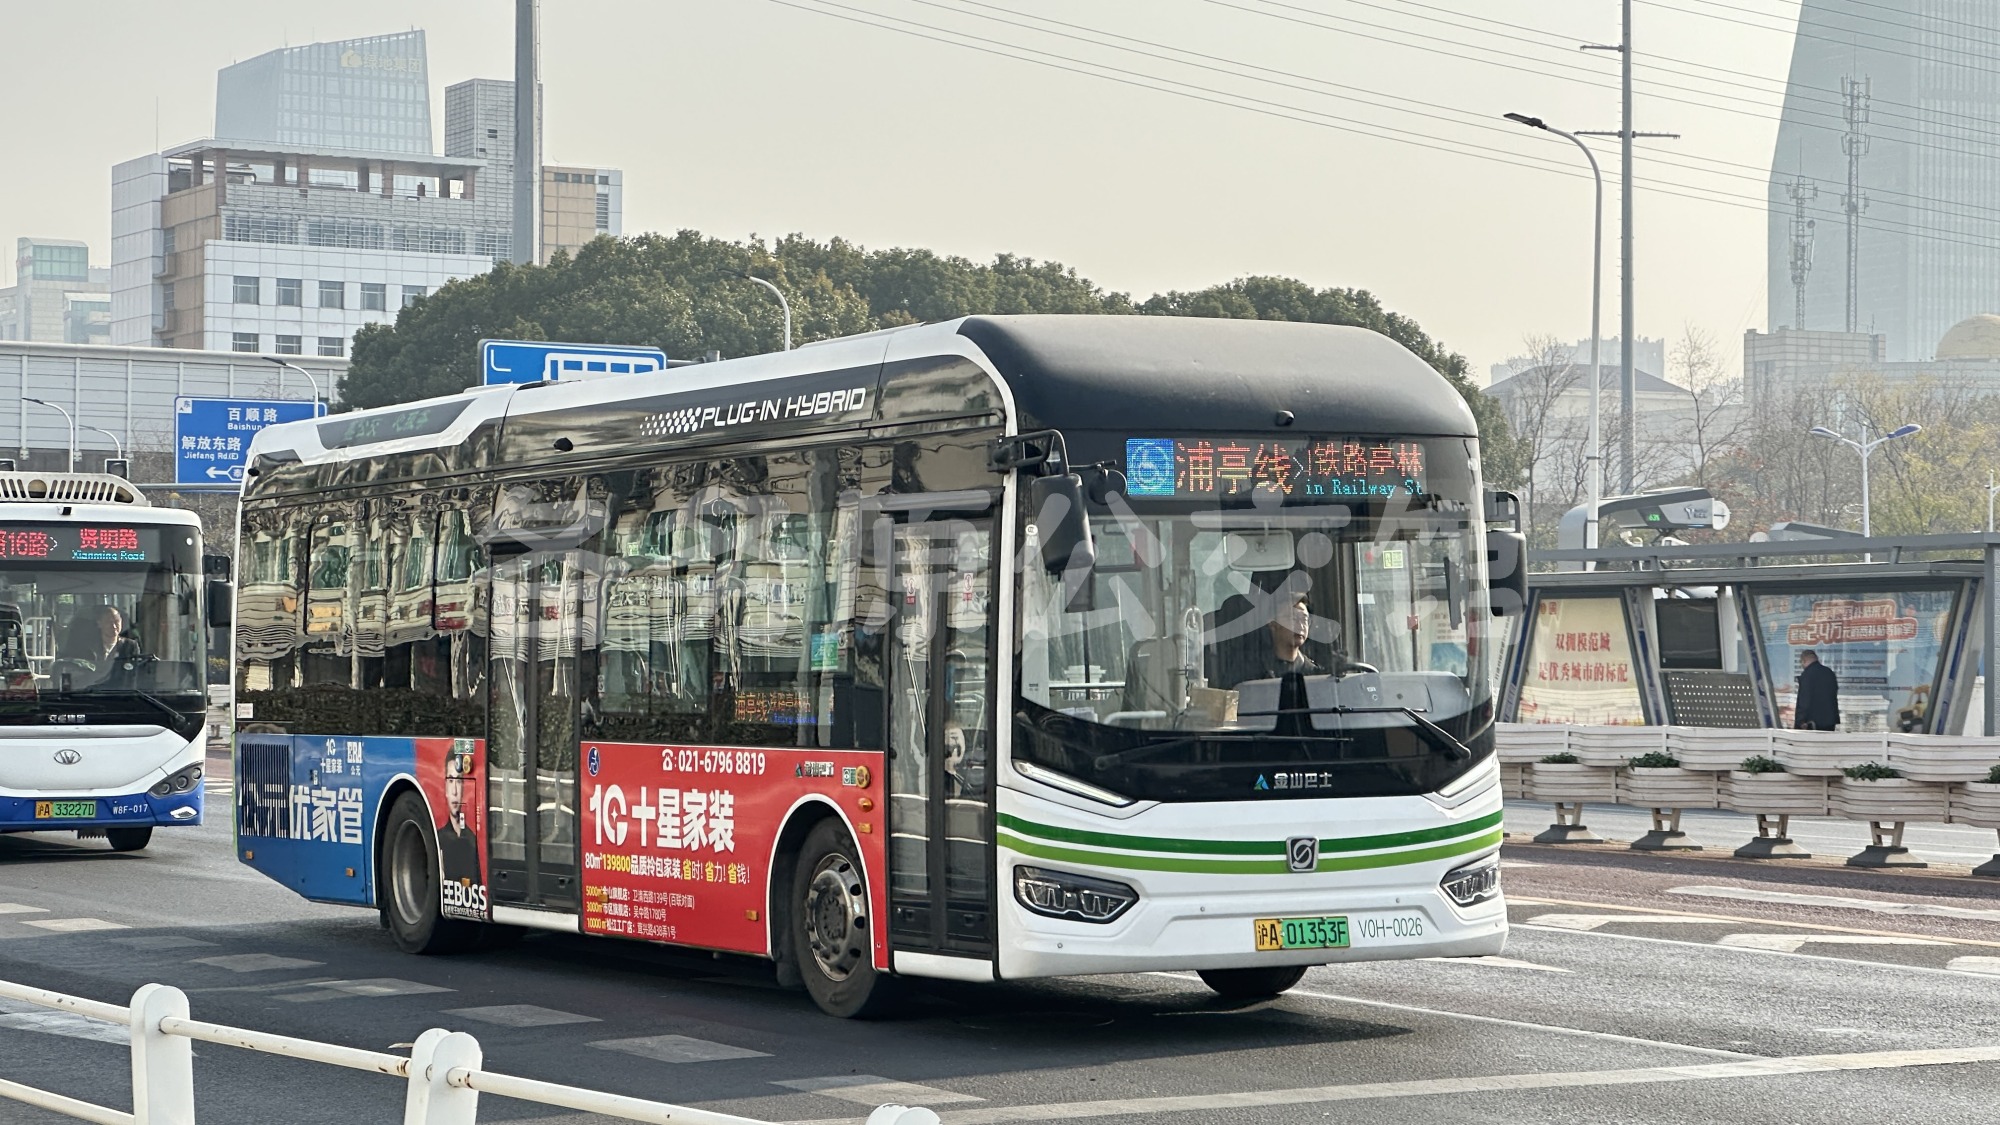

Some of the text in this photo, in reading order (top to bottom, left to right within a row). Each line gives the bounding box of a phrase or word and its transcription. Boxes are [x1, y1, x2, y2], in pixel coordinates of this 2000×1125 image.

[227, 407, 278, 422] 百顺路
[700, 387, 867, 429] PLUG-IN HYBRID
[227, 422, 262, 431] Baishun
[181, 435, 242, 451] 解放东路
[184, 452, 215, 461] Jiefang
[1177, 442, 1423, 494] 浦亭线 铁路亭林
[1306, 479, 1423, 497] in Railway St
[80, 528, 138, 549] 贤明路
[120, 551, 145, 560] Road
[1556, 632, 1611, 652] 双拥模范城
[1538, 662, 1628, 682] 是优秀城市的标配
[735, 752, 766, 775] 8819
[1273, 772, 1332, 789] 金山巴士
[112, 803, 149, 815] W8F-017
[631, 786, 735, 853] 十星家装
